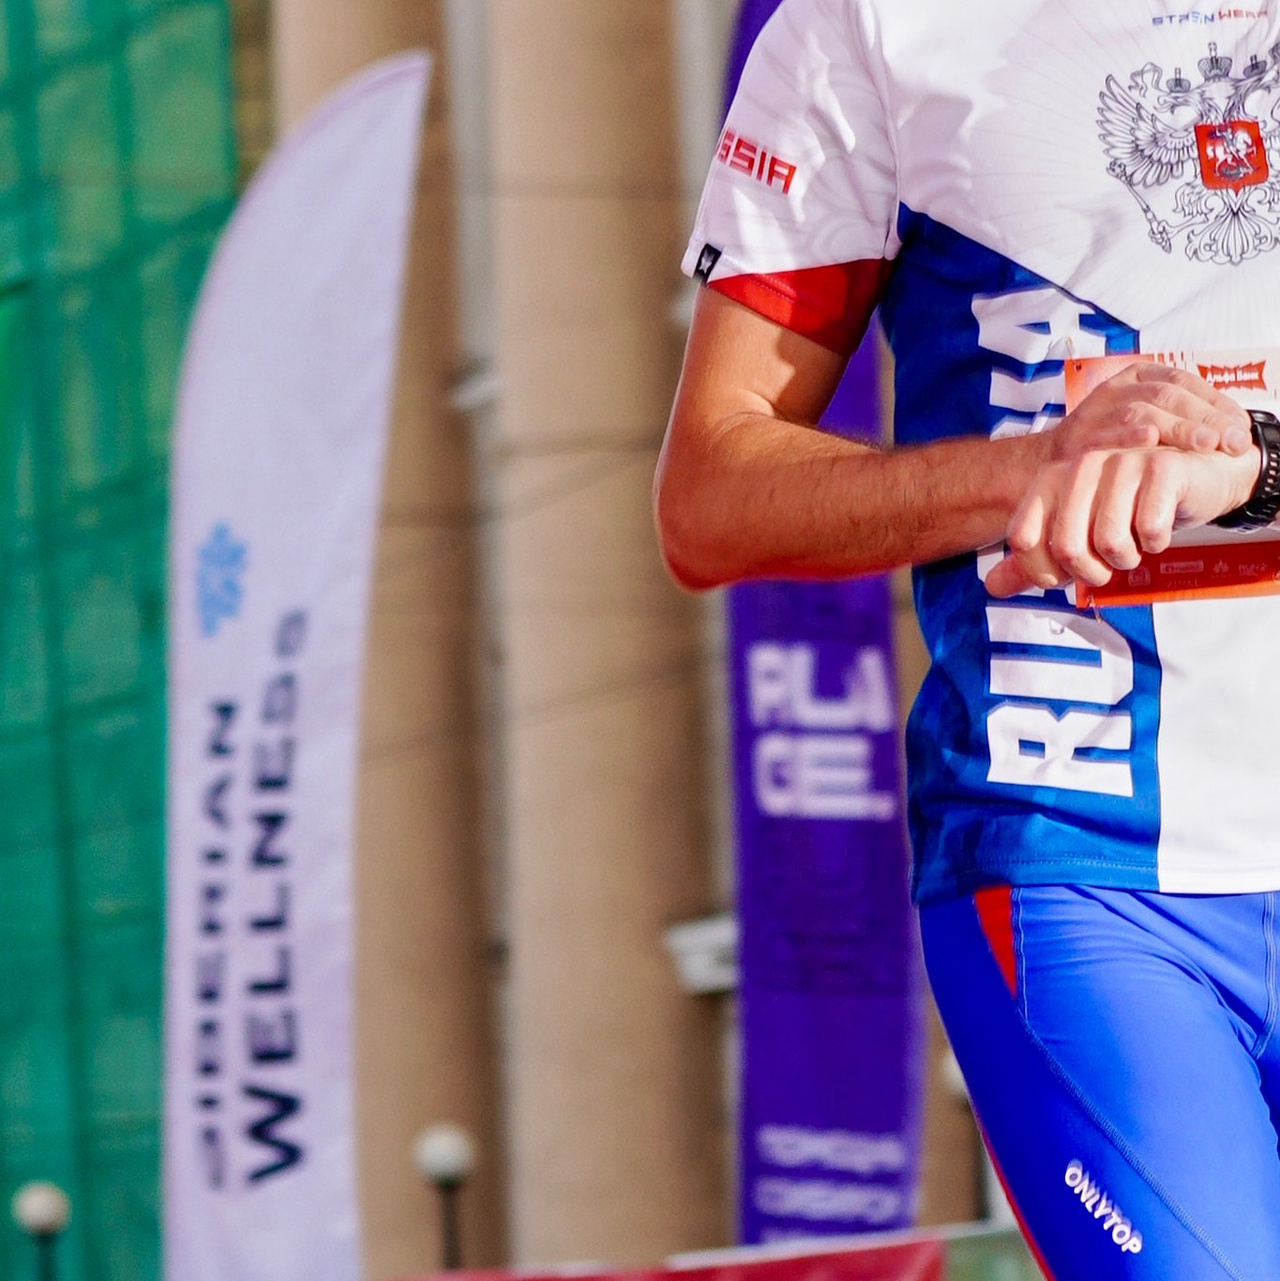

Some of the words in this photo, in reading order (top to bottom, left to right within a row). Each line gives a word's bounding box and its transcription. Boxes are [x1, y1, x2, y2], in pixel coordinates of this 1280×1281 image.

[1206, 370, 1236, 385] Альфа
[1236, 369, 1259, 382] Банк
[240, 608, 307, 1188] WELLNESS
[1064, 1160, 1143, 1254] ONLYTOP
